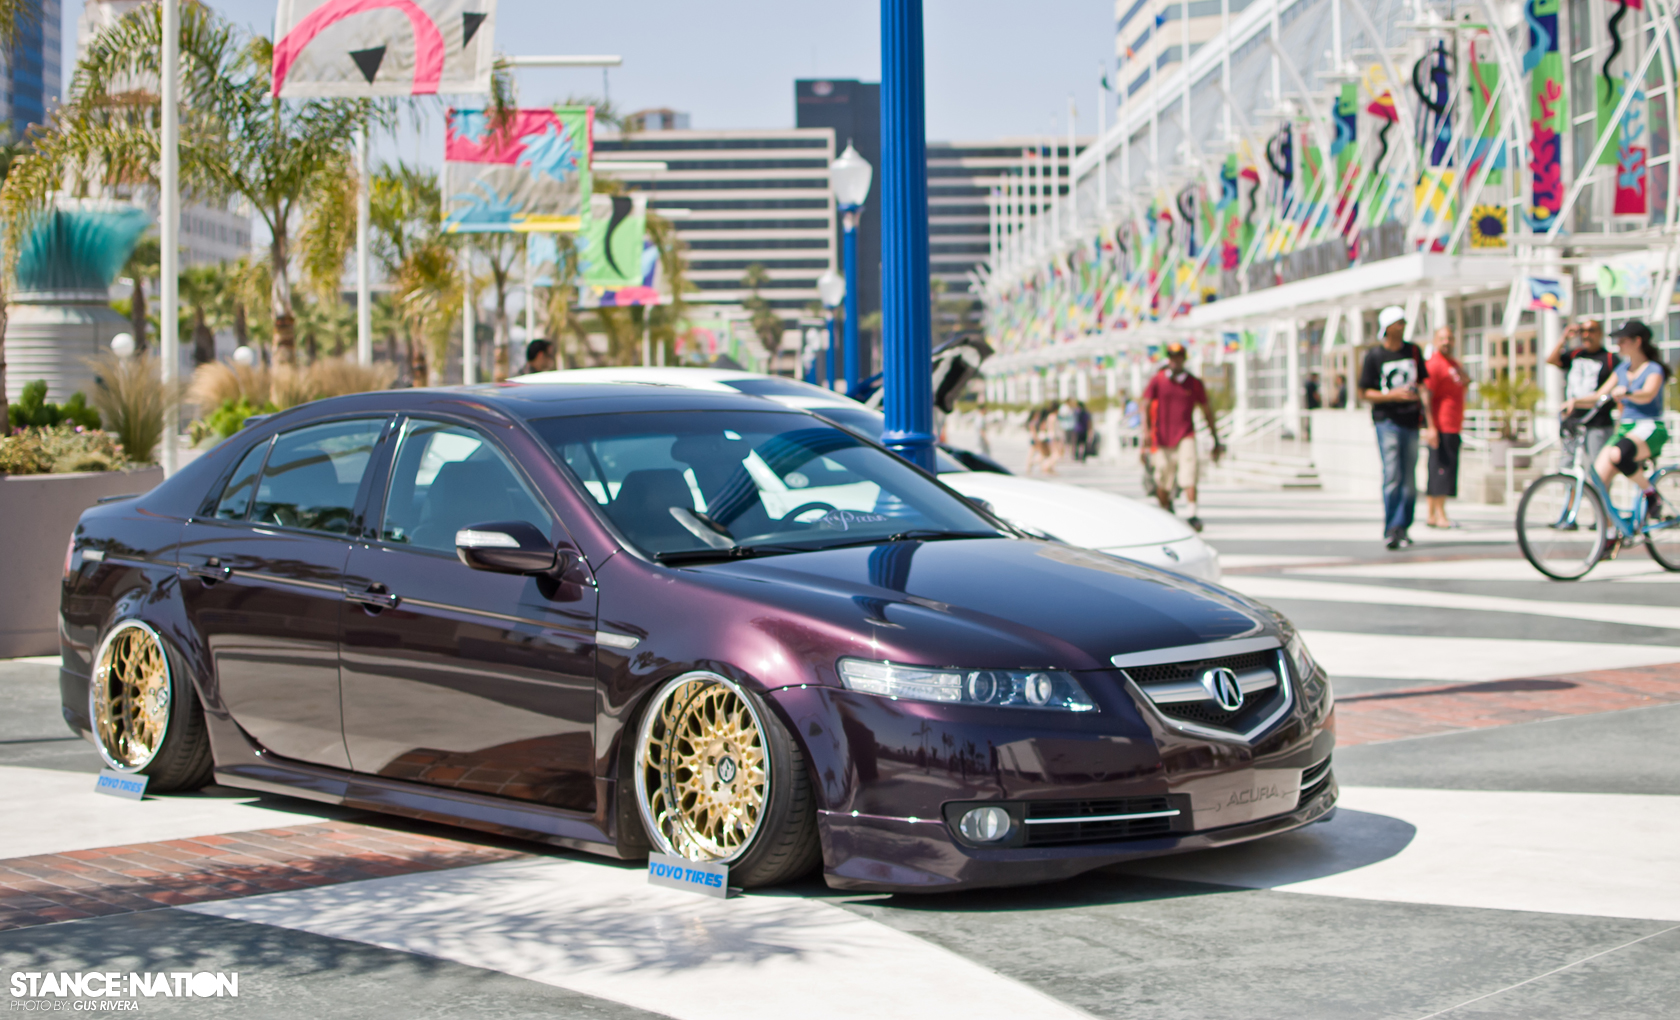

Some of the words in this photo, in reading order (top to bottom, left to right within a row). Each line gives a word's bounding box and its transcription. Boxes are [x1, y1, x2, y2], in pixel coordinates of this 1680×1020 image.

[97, 775, 120, 789] TOYO
[1226, 783, 1279, 807] ACURA
[649, 861, 684, 880] TOYO
[684, 868, 724, 888] TIRES
